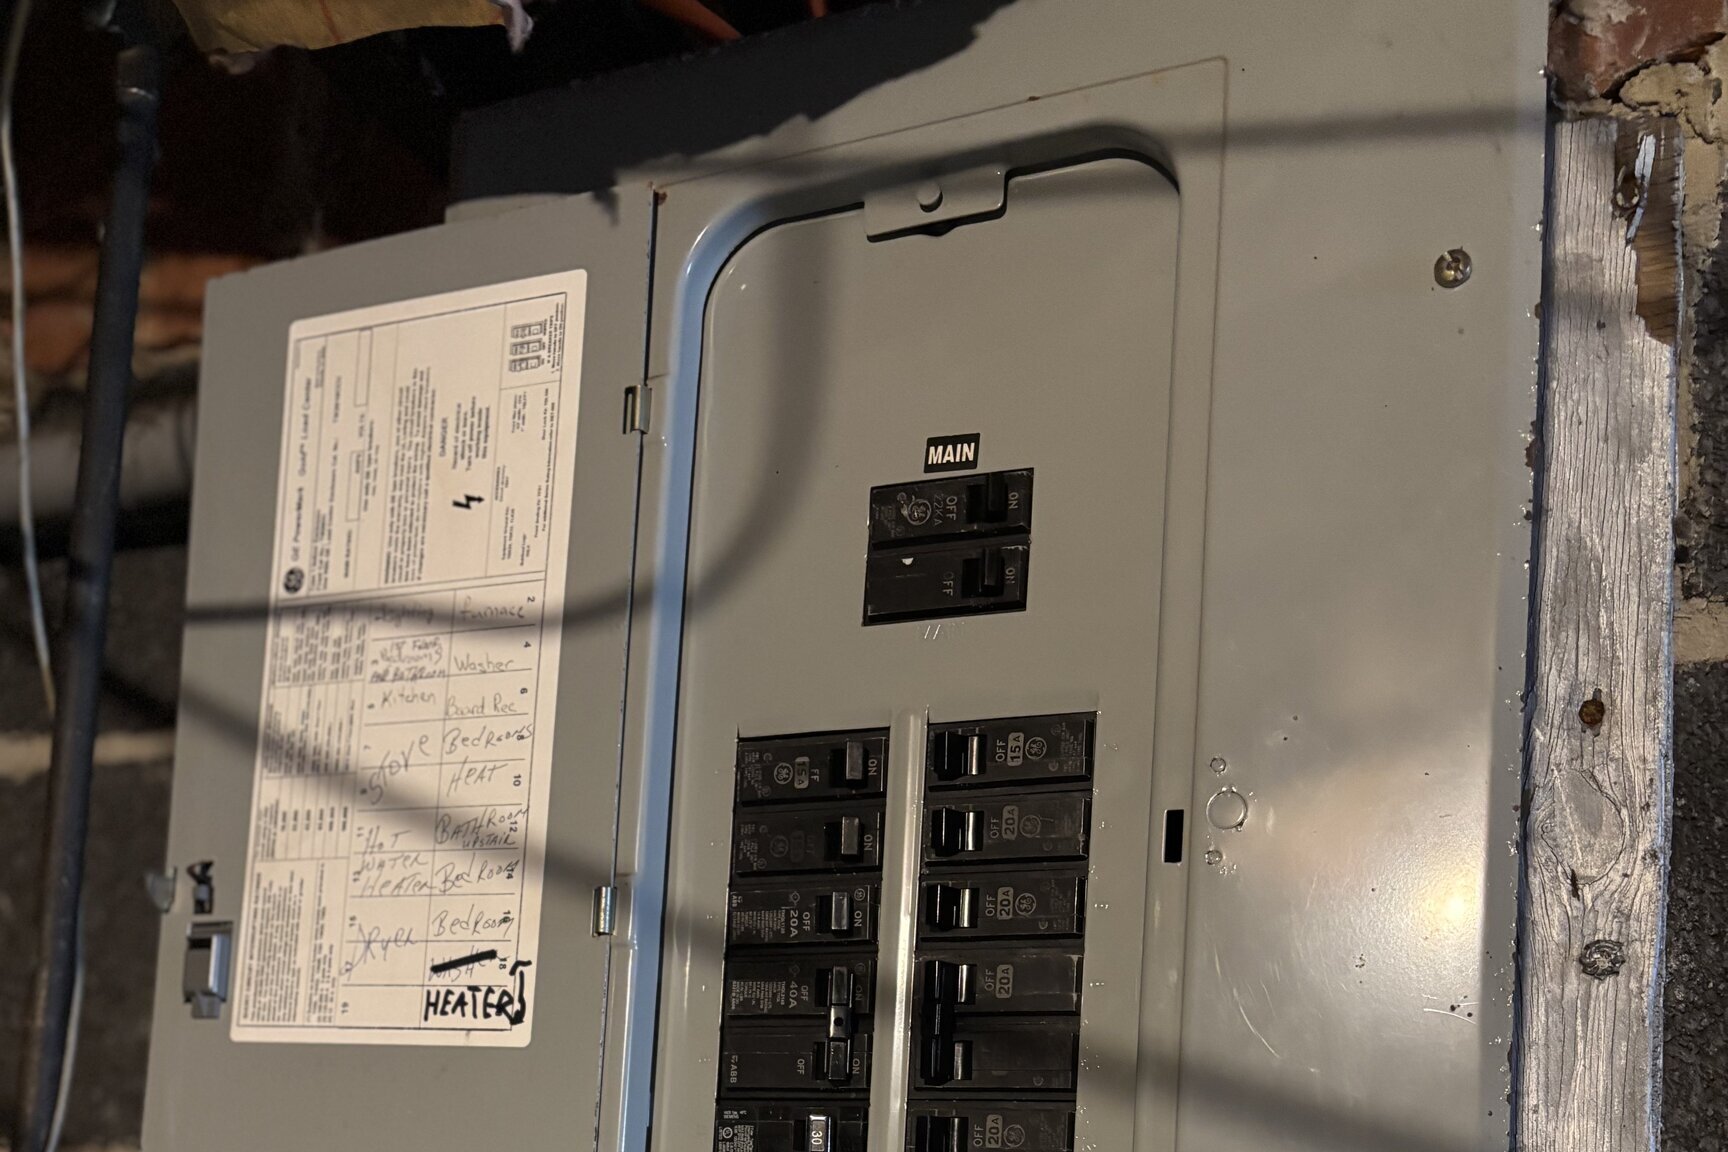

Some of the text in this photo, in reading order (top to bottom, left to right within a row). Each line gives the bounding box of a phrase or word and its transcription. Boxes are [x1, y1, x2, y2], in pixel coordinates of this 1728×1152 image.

[439, 417, 448, 457] DANGER
[927, 442, 976, 465] MAIN
[293, 486, 304, 543] PowerMark
[301, 413, 309, 440] Load
[946, 496, 958, 521] OFF
[1008, 492, 1019, 509] ON
[1005, 567, 1015, 584] ON
[523, 641, 532, 649] 4
[454, 653, 514, 674] Washer
[381, 687, 437, 709] Kitchen
[520, 687, 528, 695] 6
[995, 739, 1006, 762] OFF
[1010, 735, 1021, 762] 15A
[796, 760, 807, 786] 15A
[868, 759, 877, 776] ON
[512, 774, 522, 787] 10
[509, 821, 518, 833] 12
[990, 817, 1000, 838] OFF
[1004, 808, 1015, 835] 20A
[864, 834, 873, 851] ON
[505, 867, 514, 879] 14
[985, 895, 996, 917] OFF
[1000, 890, 1012, 917] 20A
[789, 910, 799, 938] 20A
[803, 912, 811, 932] OFF
[854, 910, 863, 927] ON
[498, 958, 507, 970] 18
[984, 969, 995, 991] OFF
[998, 967, 1011, 995] 20A
[789, 981, 799, 1009] 40A
[801, 985, 809, 1001] OFF
[730, 1065, 738, 1084] ABB
[797, 1059, 805, 1075] OFF
[852, 1057, 860, 1075] ON
[811, 1130, 823, 1145] 30
[973, 1124, 984, 1147] OFF
[988, 1117, 1001, 1146] 20A
